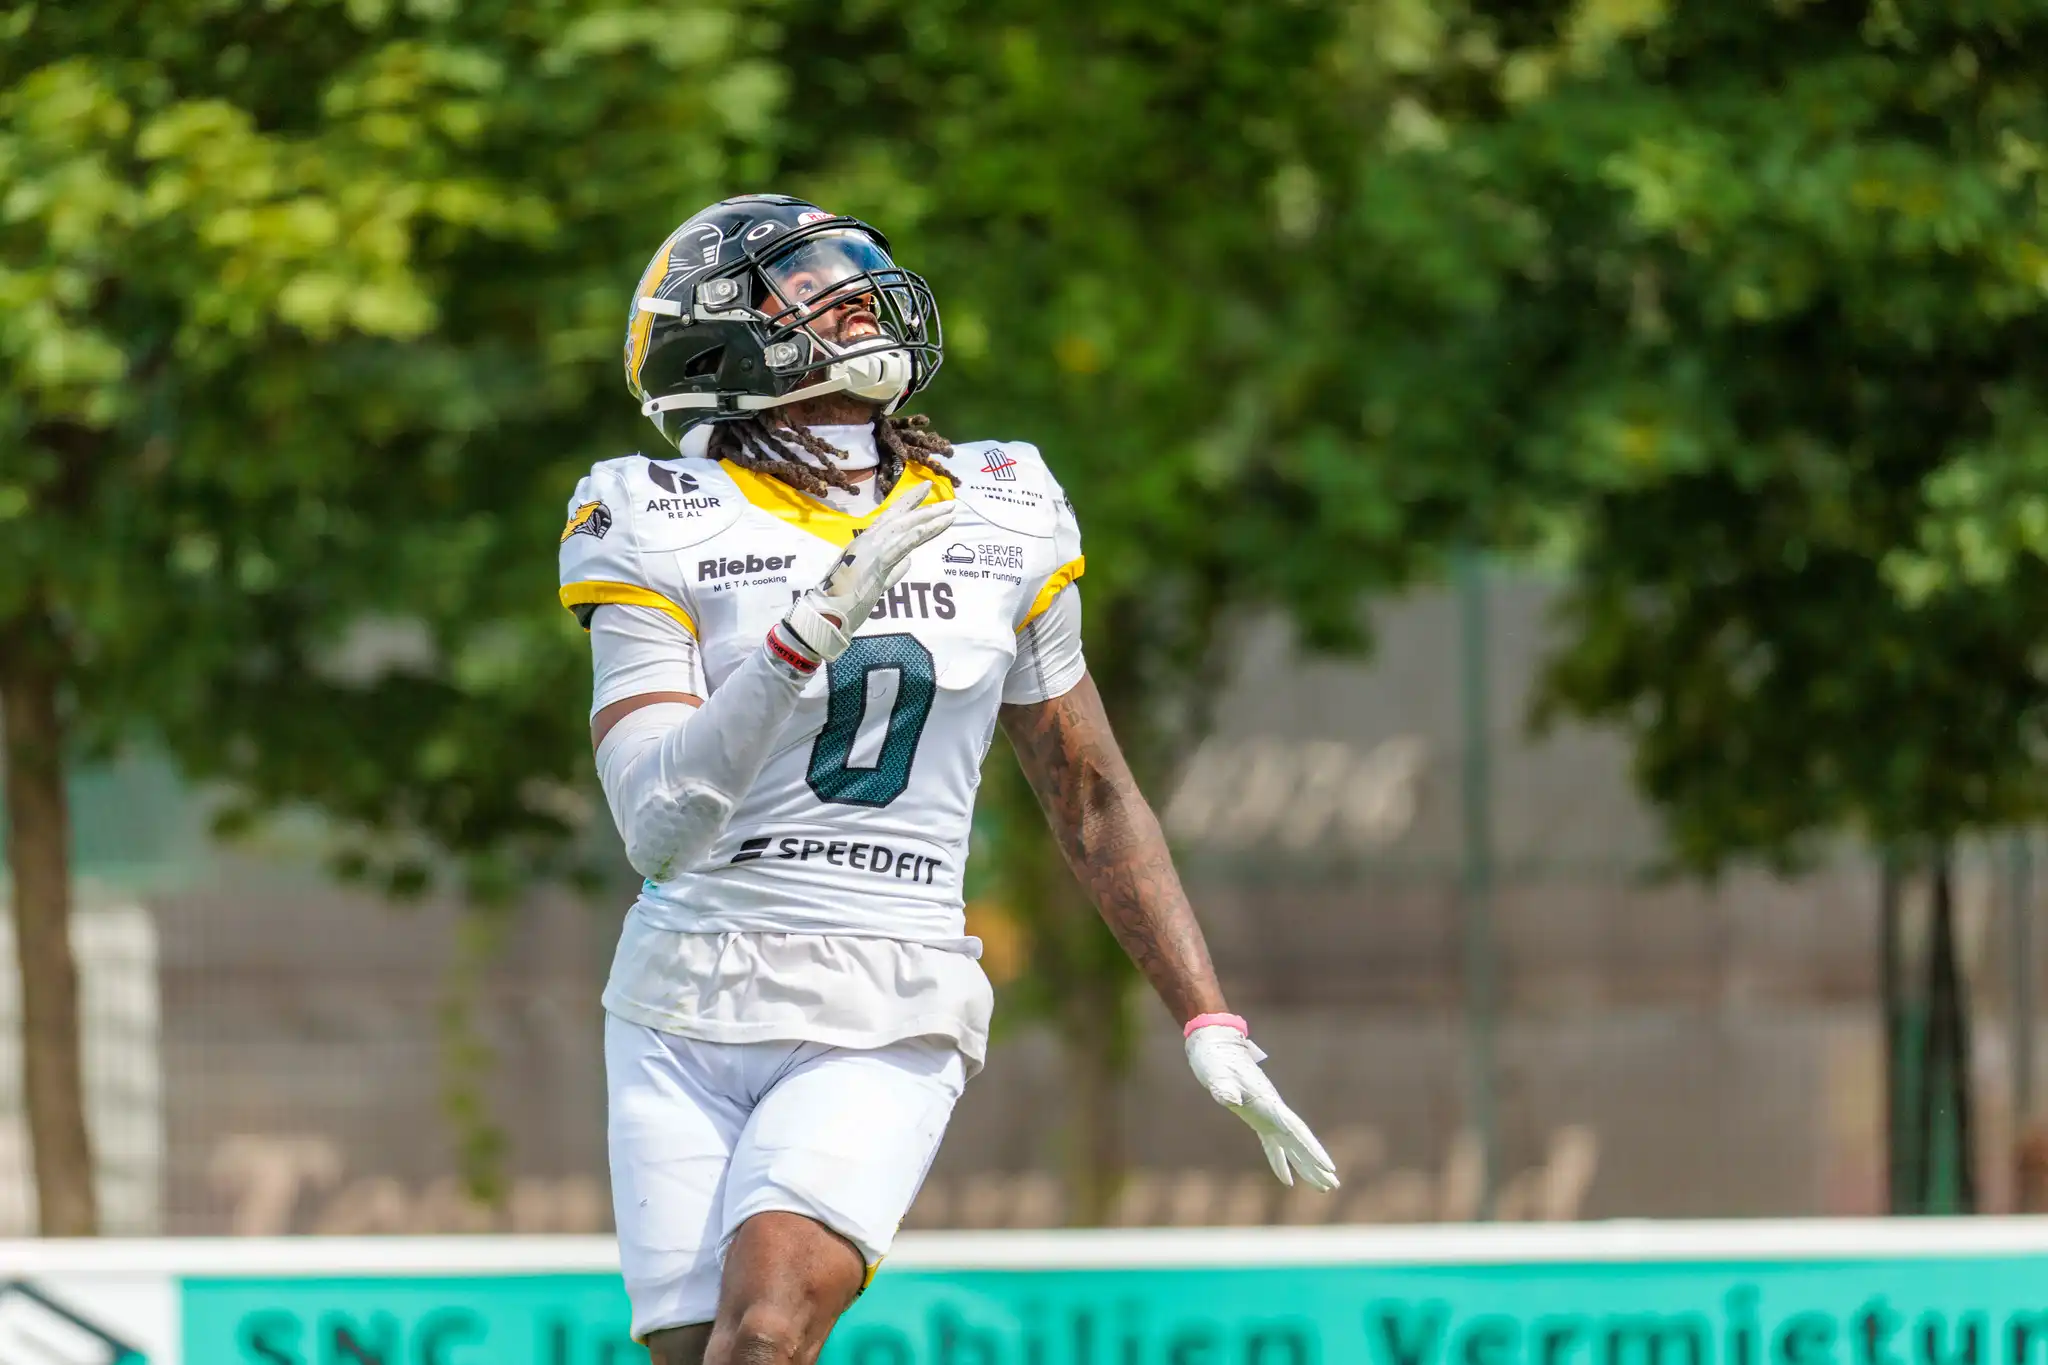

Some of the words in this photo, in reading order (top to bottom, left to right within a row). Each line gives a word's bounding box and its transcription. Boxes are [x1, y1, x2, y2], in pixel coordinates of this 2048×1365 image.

[646, 497, 721, 512] ARTHUR
[668, 511, 702, 519] REAL
[978, 544, 1023, 557] SERVER
[698, 554, 797, 582] Rieber
[979, 555, 1023, 569] HEAVEN
[714, 580, 749, 592] META
[752, 575, 788, 586] cooking
[944, 568, 957, 576] we
[959, 569, 979, 579] keep
[981, 570, 990, 579] IT
[993, 572, 1022, 585] running
[805, 632, 937, 808] 0
[777, 837, 942, 885] SPEEDFIT
